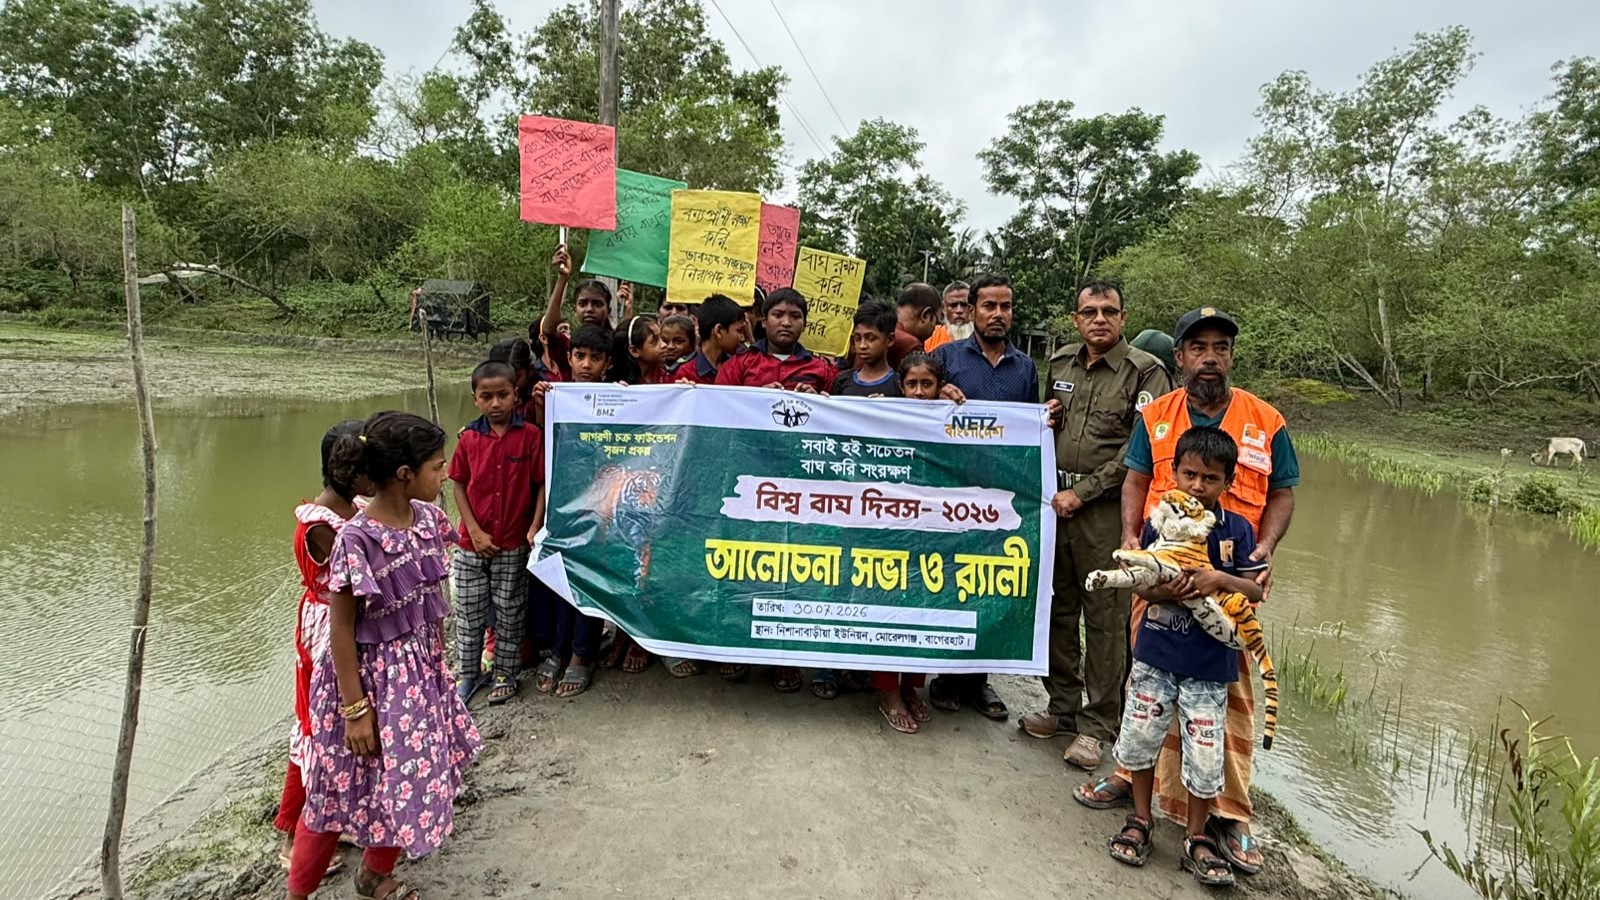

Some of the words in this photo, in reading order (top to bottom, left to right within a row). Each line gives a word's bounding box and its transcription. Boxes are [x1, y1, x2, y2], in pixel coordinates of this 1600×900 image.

[800, 253, 829, 274] বাঘ
[680, 264, 724, 286] নিরাপদ
[596, 408, 615, 417] BMZ
[944, 423, 1004, 440] বাংলাদেশ
[951, 415, 998, 431] NETZ
[580, 429, 612, 443] জাগরণী
[614, 433, 632, 444] চক্র
[634, 431, 677, 443] ফাউন্ডেশন
[604, 445, 626, 459] সৃজন
[628, 446, 652, 457] প্রকল্প
[801, 437, 838, 456] সবাই
[840, 438, 863, 458] হই
[866, 443, 916, 460] সচেতন
[800, 458, 827, 475] বাঘ
[829, 457, 857, 477] করি
[860, 463, 913, 480] সংরক্ষণ
[756, 481, 802, 516] বিশ্ব
[810, 492, 853, 515] বাঘ
[942, 500, 1000, 525] ২০২৬
[705, 538, 843, 587] আলোচনা
[851, 547, 910, 591] সভা
[919, 552, 945, 594] ও
[776, 623, 832, 640] নিশানাবাড়ীয়া
